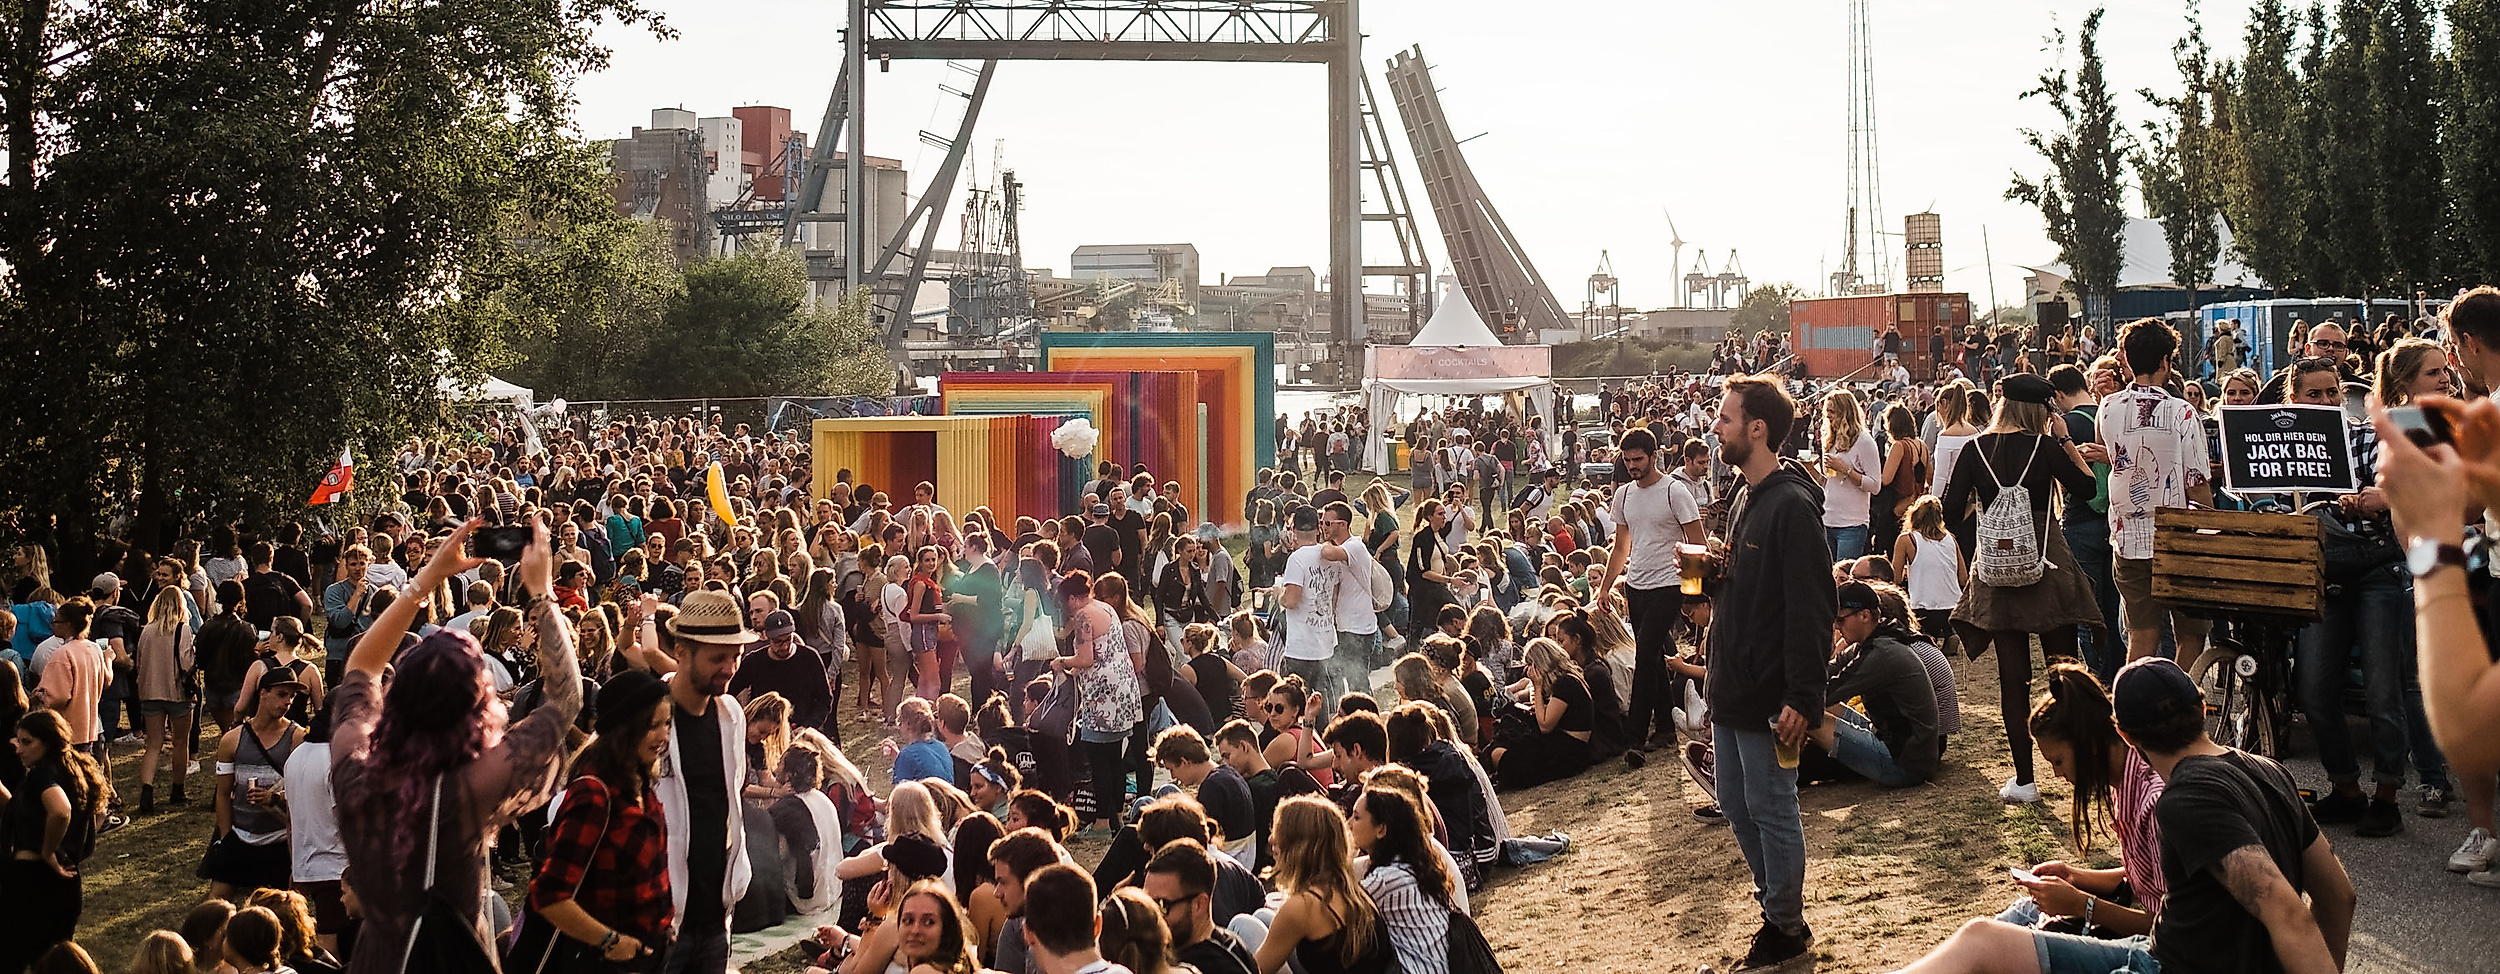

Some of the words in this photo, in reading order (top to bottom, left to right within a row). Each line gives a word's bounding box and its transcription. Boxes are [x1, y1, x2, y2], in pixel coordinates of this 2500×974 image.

[1438, 358, 1487, 366] COCKTAILS
[2245, 433, 2263, 442] HOL
[2265, 433, 2282, 442] DIR
[2283, 432, 2305, 441] HIER
[2306, 433, 2327, 442] DEIN
[2247, 444, 2292, 460] JACK
[2295, 443, 2332, 460] BAG.
[2249, 461, 2283, 477] FOR
[2286, 461, 2331, 477] FREE!
